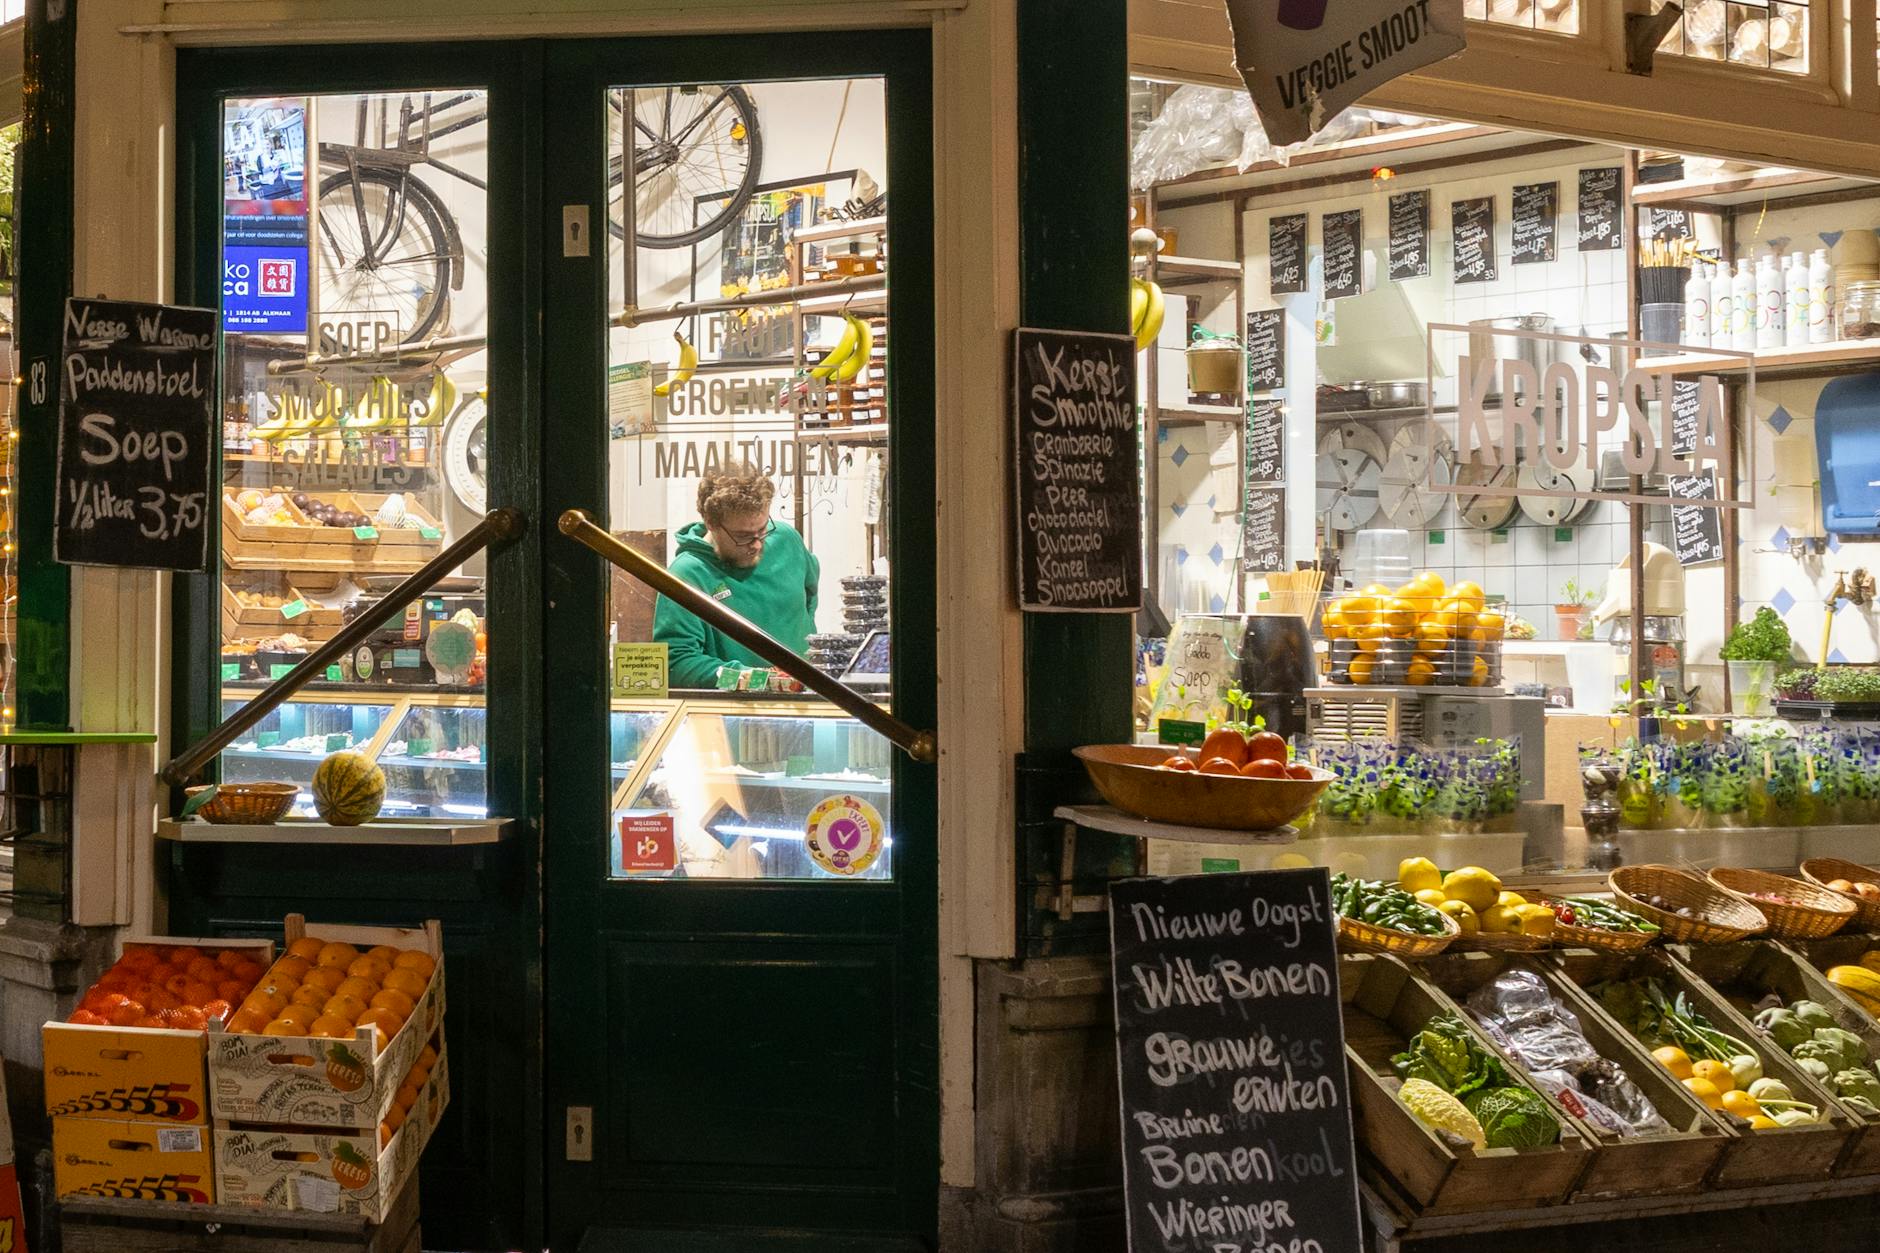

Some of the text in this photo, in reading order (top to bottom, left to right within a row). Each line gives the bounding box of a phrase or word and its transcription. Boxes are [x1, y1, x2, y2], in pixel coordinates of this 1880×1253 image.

[1276, 40, 1357, 110] VEGGIE
[318, 321, 391, 359] SOEP
[709, 315, 792, 353] FRUIT
[31, 361, 46, 405] 83
[66, 353, 203, 402] Paddenstoel
[668, 376, 828, 417] GROENTEN
[266, 381, 432, 421] SMOOTHIES
[1031, 384, 1133, 431] Smoothie
[1458, 355, 1730, 479] KROPSLA
[80, 413, 188, 481] Soep
[282, 446, 412, 486] SALADES
[655, 439, 840, 479] MAALTIJDEN
[1033, 454, 1105, 483] Spinazie
[1036, 554, 1090, 580] Kaneel
[1036, 577, 1129, 607] Sinaasappel
[1171, 667, 1211, 694] Soep
[848, 810, 871, 832] EXPERT
[1131, 885, 1325, 948] Nieuwe Oogst
[1132, 956, 1331, 1010] Witte Bonen
[221, 1035, 244, 1051] BOM
[226, 1046, 249, 1061] DIA!
[328, 1061, 362, 1085] TERESO
[227, 1133, 250, 1147] BOM
[232, 1144, 256, 1158] DIA!
[333, 1160, 368, 1182] TERESO
[1141, 1146, 1274, 1190] Bonen
